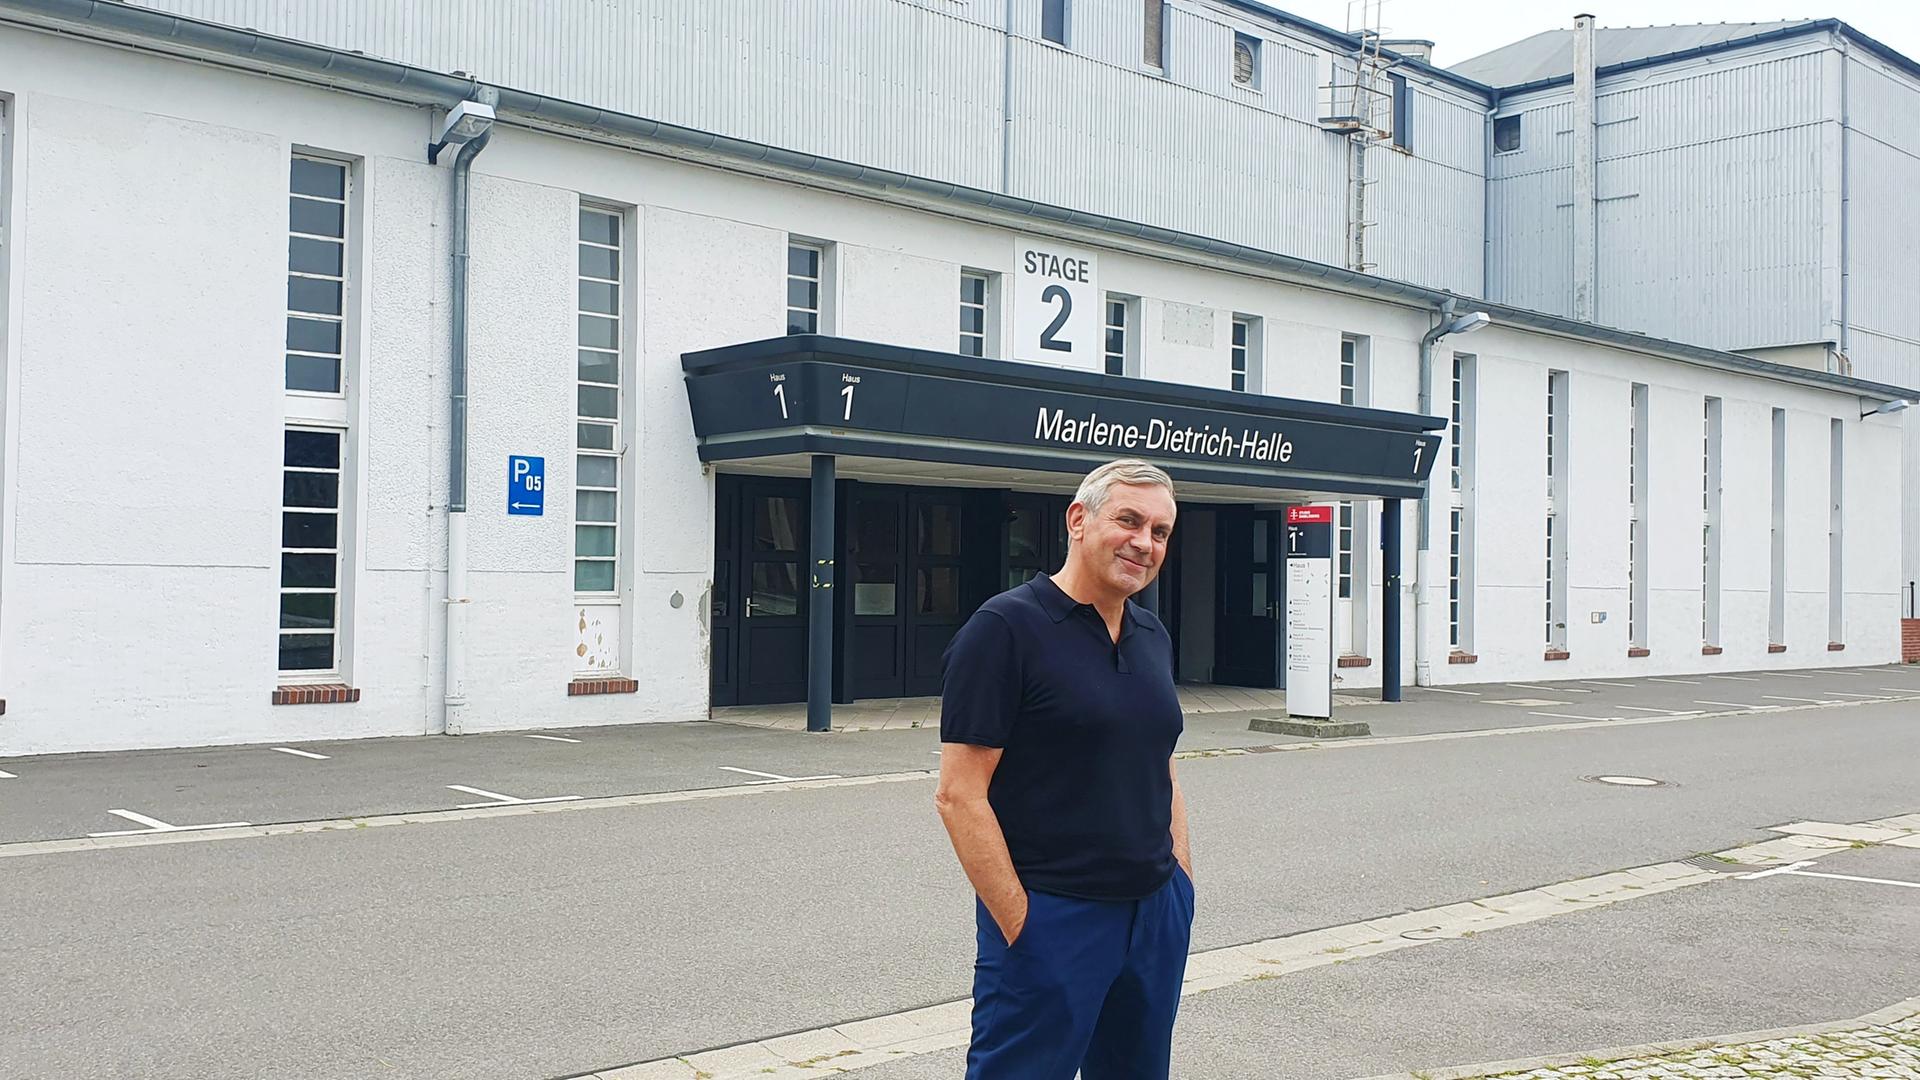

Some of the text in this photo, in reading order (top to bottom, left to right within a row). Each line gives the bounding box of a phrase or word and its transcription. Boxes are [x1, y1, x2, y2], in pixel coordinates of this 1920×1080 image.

[1024, 250, 1089, 283] STAGE
[1040, 284, 1072, 352] 2
[770, 373, 786, 382] Haus
[842, 373, 860, 383] Haus
[774, 384, 788, 419] 1
[841, 385, 854, 420] 1
[1034, 407, 1293, 462] Marlene-Dietrich-Halle
[514, 459, 542, 491] P 05
[1413, 447, 1422, 474] 1
[1289, 531, 1296, 552] 1
